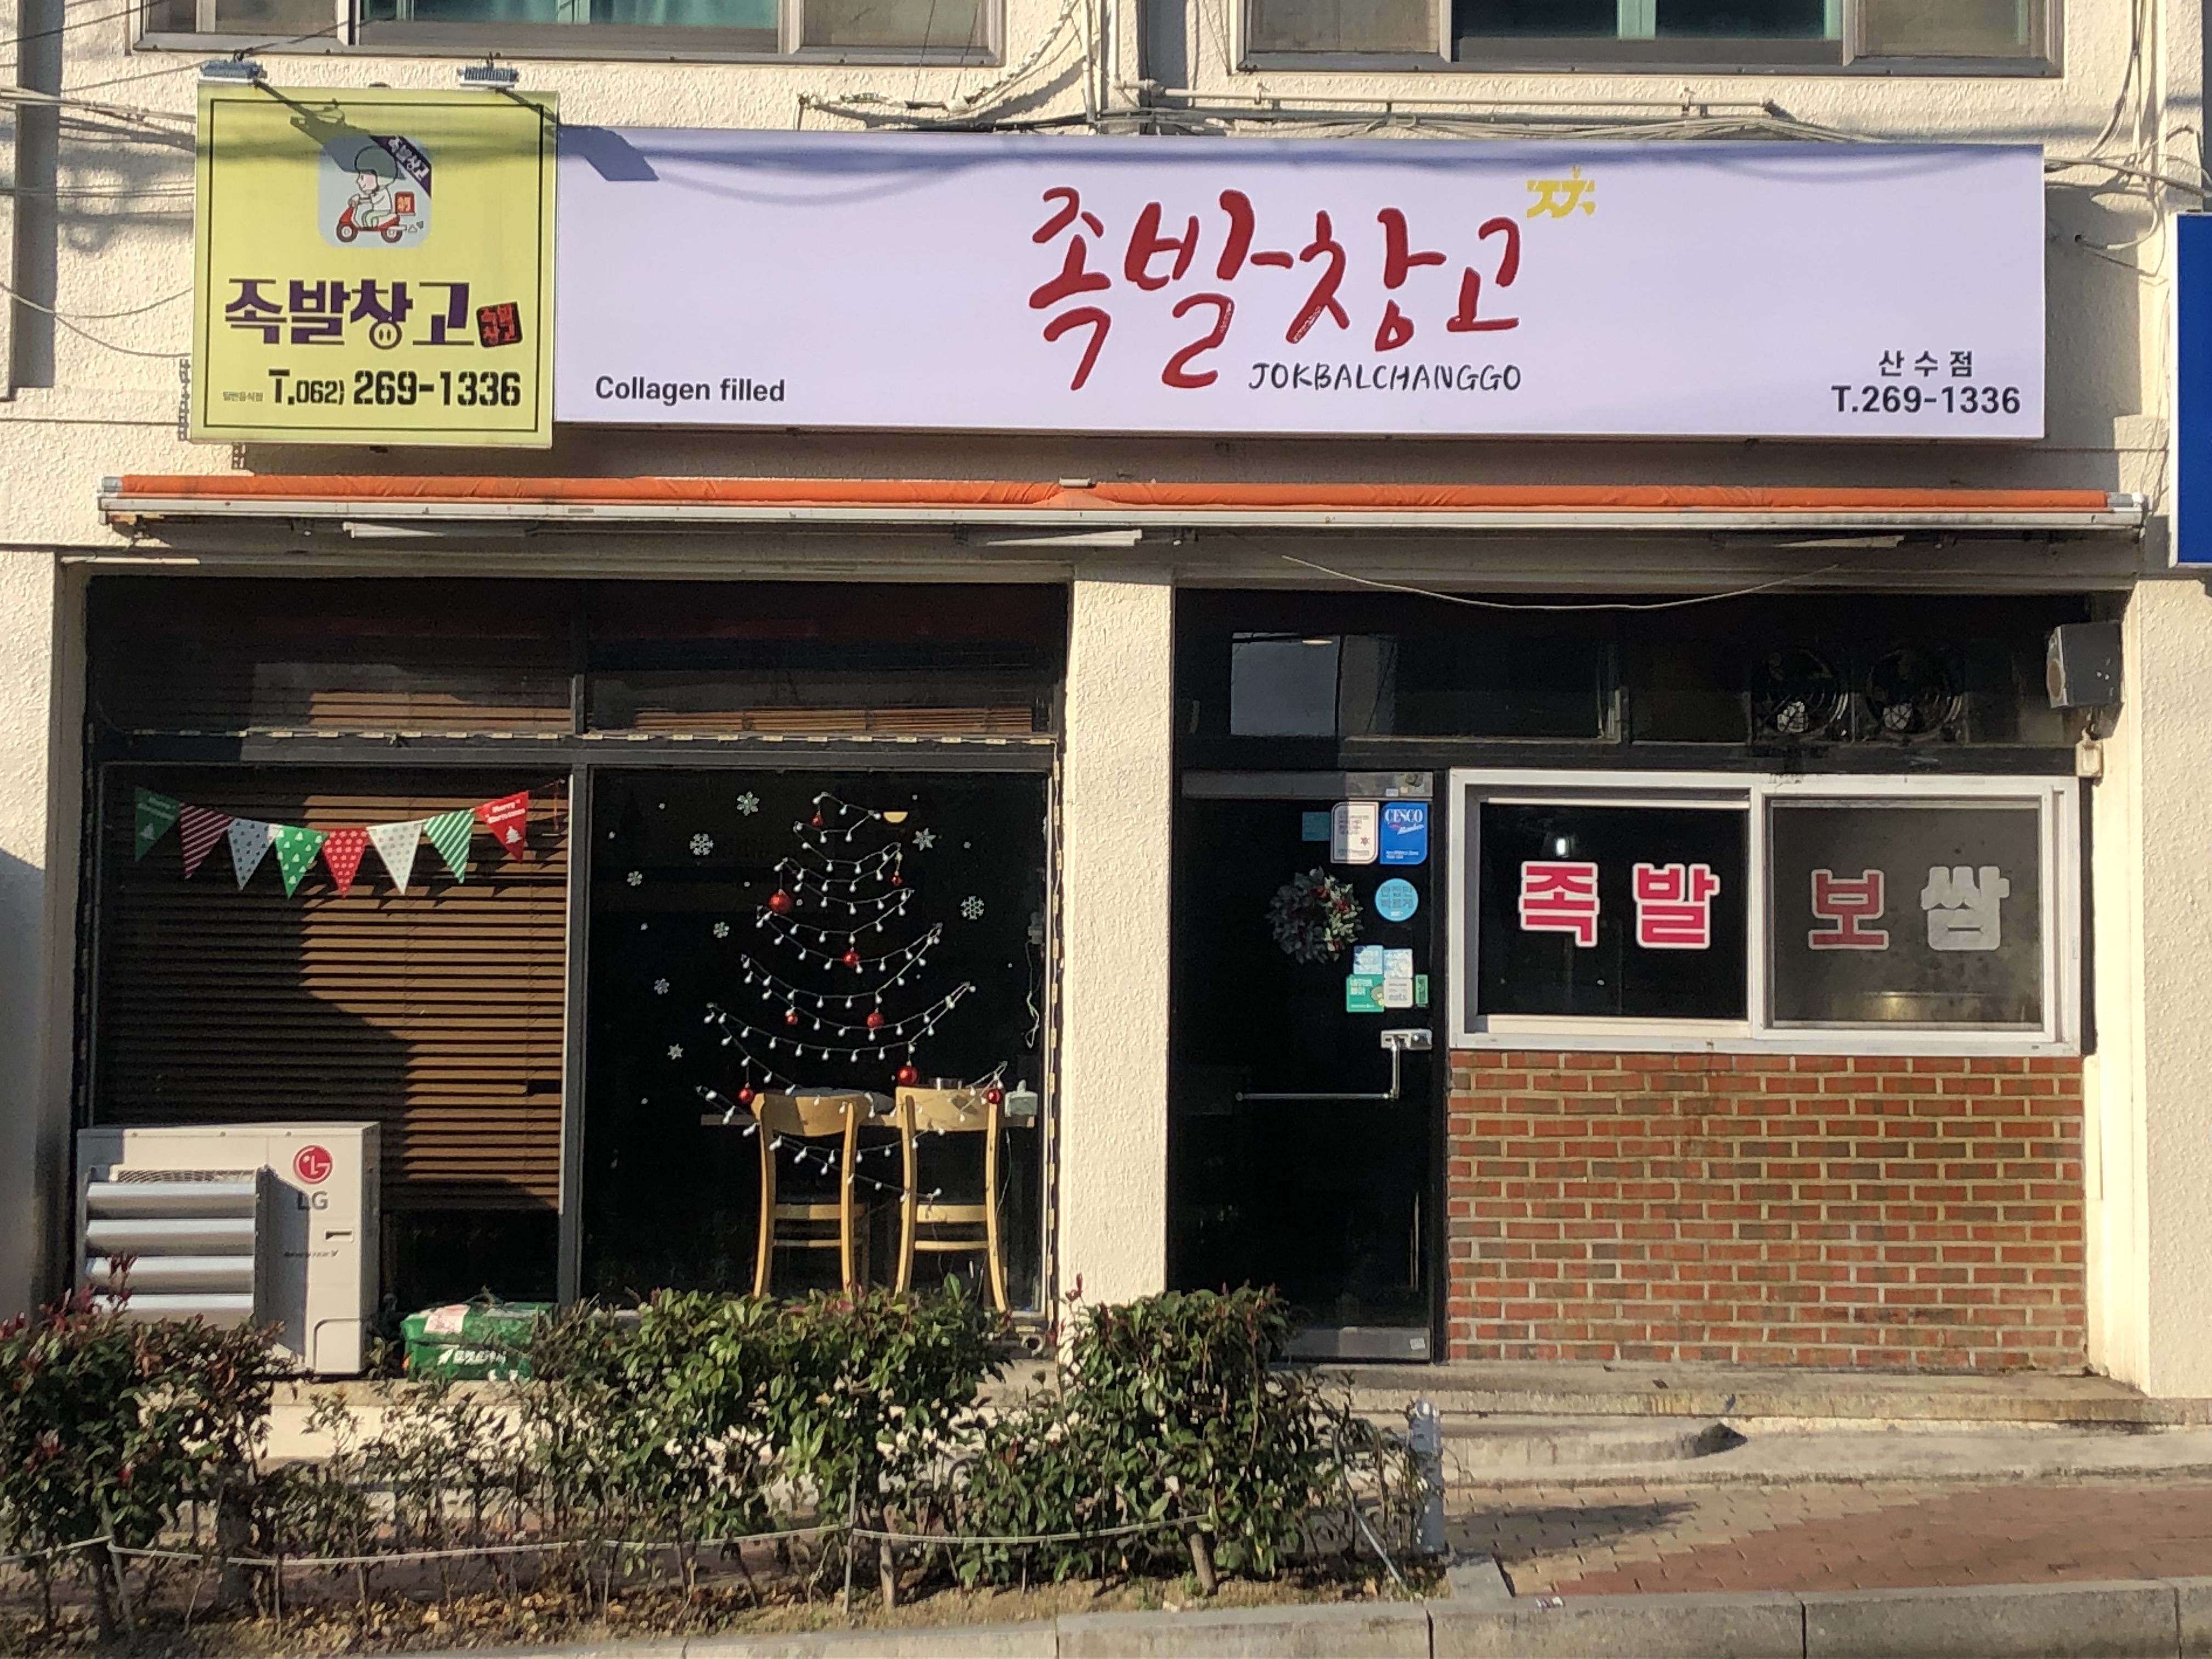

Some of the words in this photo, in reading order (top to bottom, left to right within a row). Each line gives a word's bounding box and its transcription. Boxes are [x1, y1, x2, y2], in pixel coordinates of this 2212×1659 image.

[1029, 186, 1520, 391] 족발창고
[225, 278, 475, 350] 족발창고
[353, 370, 521, 407] 269-1336
[595, 376, 710, 407] Collagen
[720, 377, 785, 402] filled
[1248, 363, 1521, 391] JOKBALCHANGGO
[1831, 385, 2021, 414] T.269-1336
[1385, 809, 1423, 823] CESCO
[297, 1190, 329, 1211] LG
